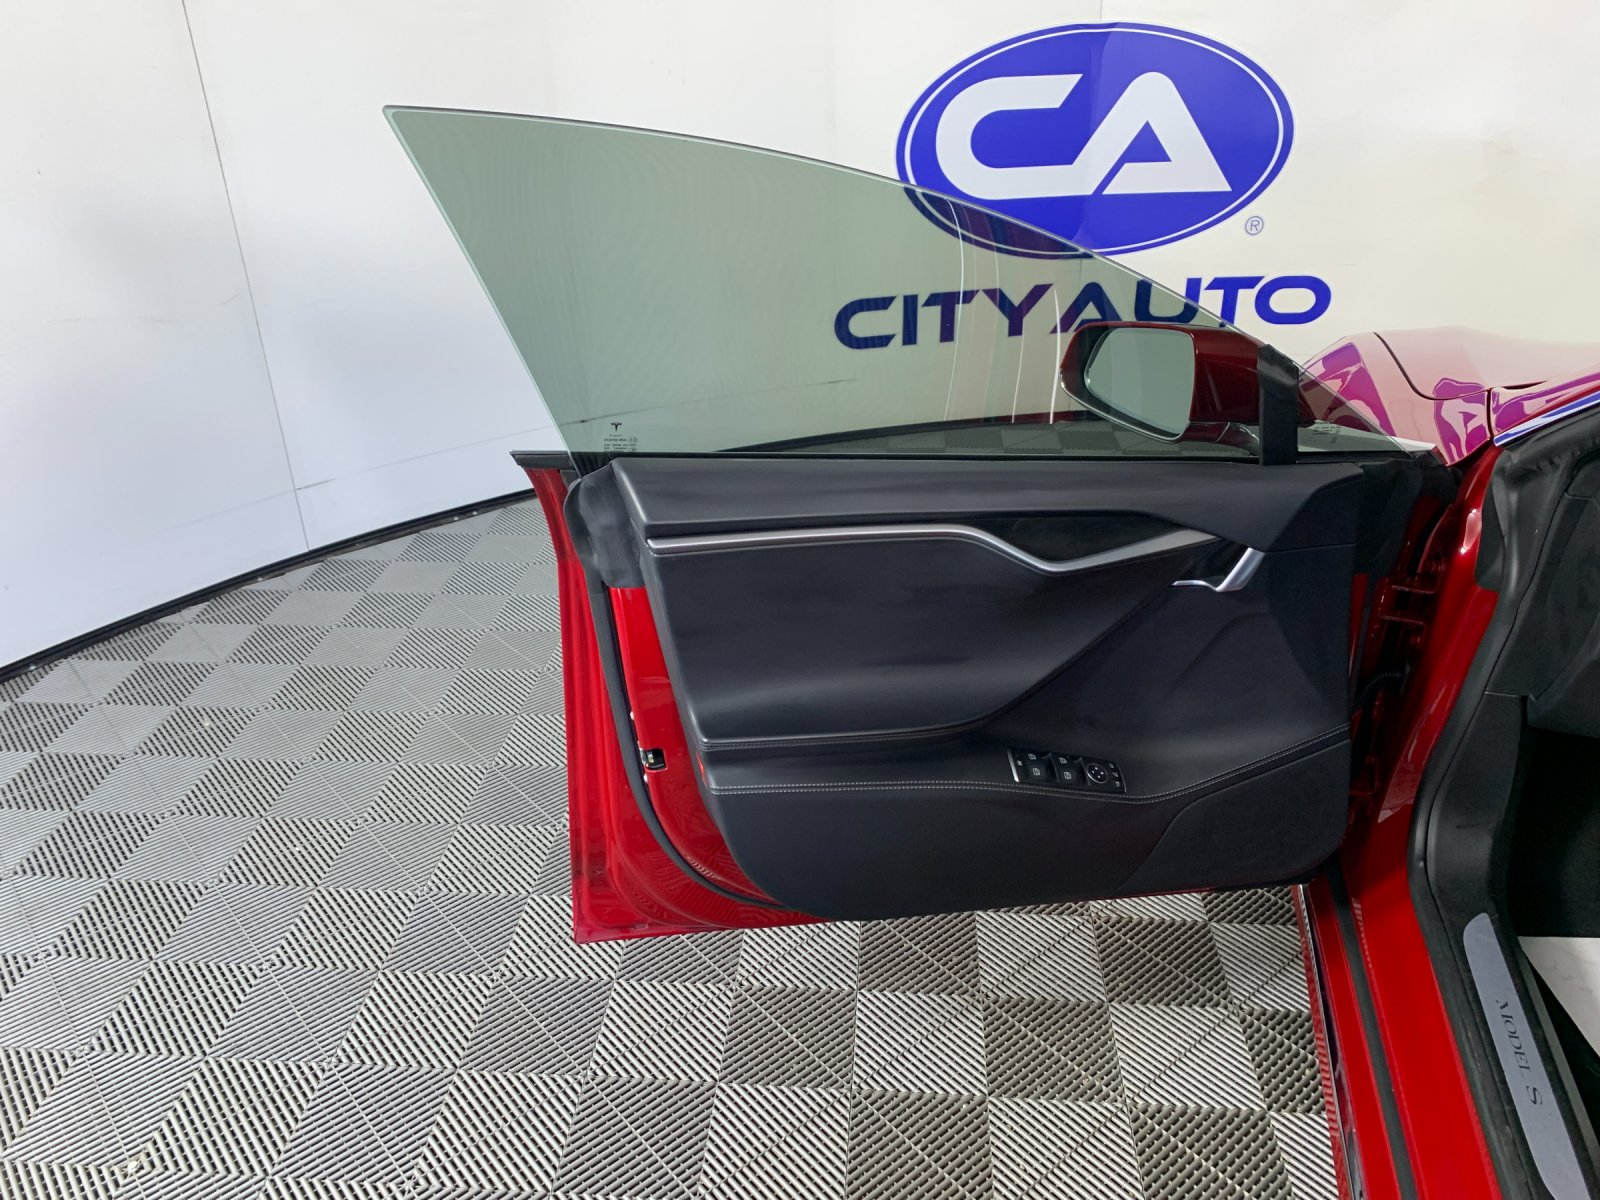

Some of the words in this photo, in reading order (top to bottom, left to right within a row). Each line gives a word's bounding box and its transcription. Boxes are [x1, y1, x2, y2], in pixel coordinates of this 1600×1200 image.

[935, 71, 1232, 200] CA
[1496, 999, 1531, 1078] MODEL
[1525, 1085, 1543, 1105] S
